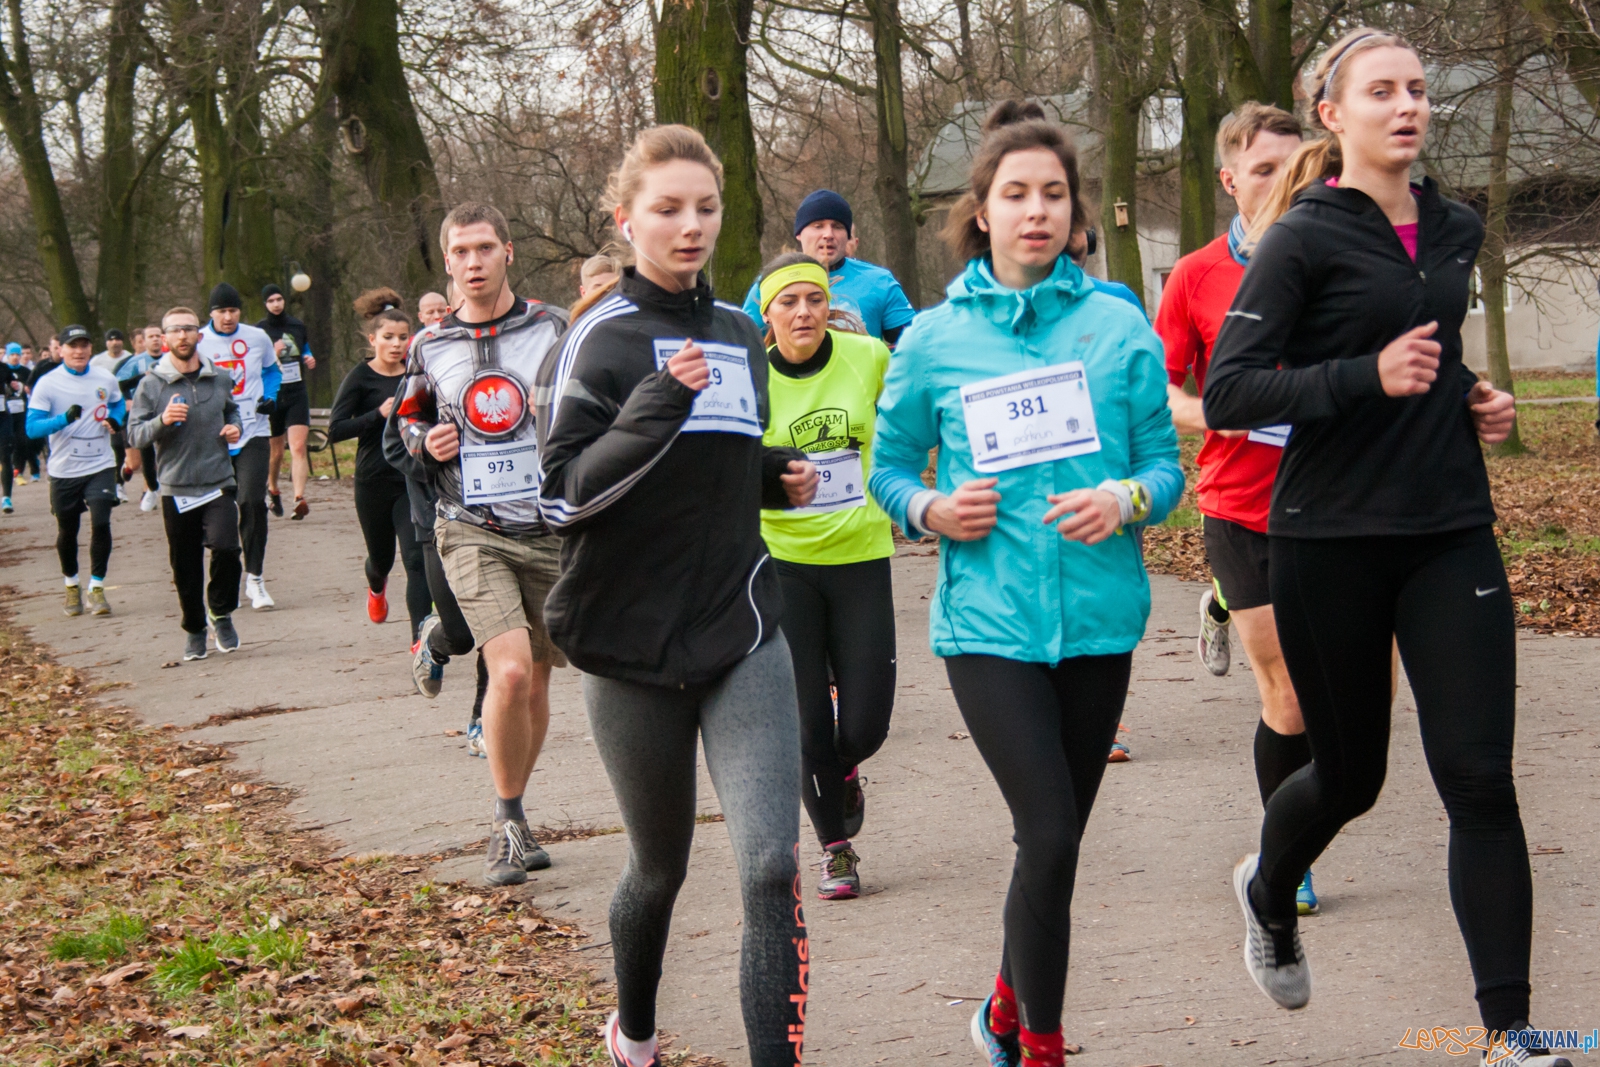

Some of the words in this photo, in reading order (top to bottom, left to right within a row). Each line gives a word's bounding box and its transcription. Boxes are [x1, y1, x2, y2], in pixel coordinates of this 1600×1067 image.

[710, 367, 722, 385] 9
[986, 384, 1022, 399] POWSTANIA
[1022, 371, 1080, 389] WIELKOPOLSKIEGO
[1007, 395, 1048, 420] 381
[793, 414, 844, 435] BIEGAM
[1013, 427, 1053, 446] parkrun
[488, 460, 514, 473] 973
[815, 490, 838, 499] arkrun
